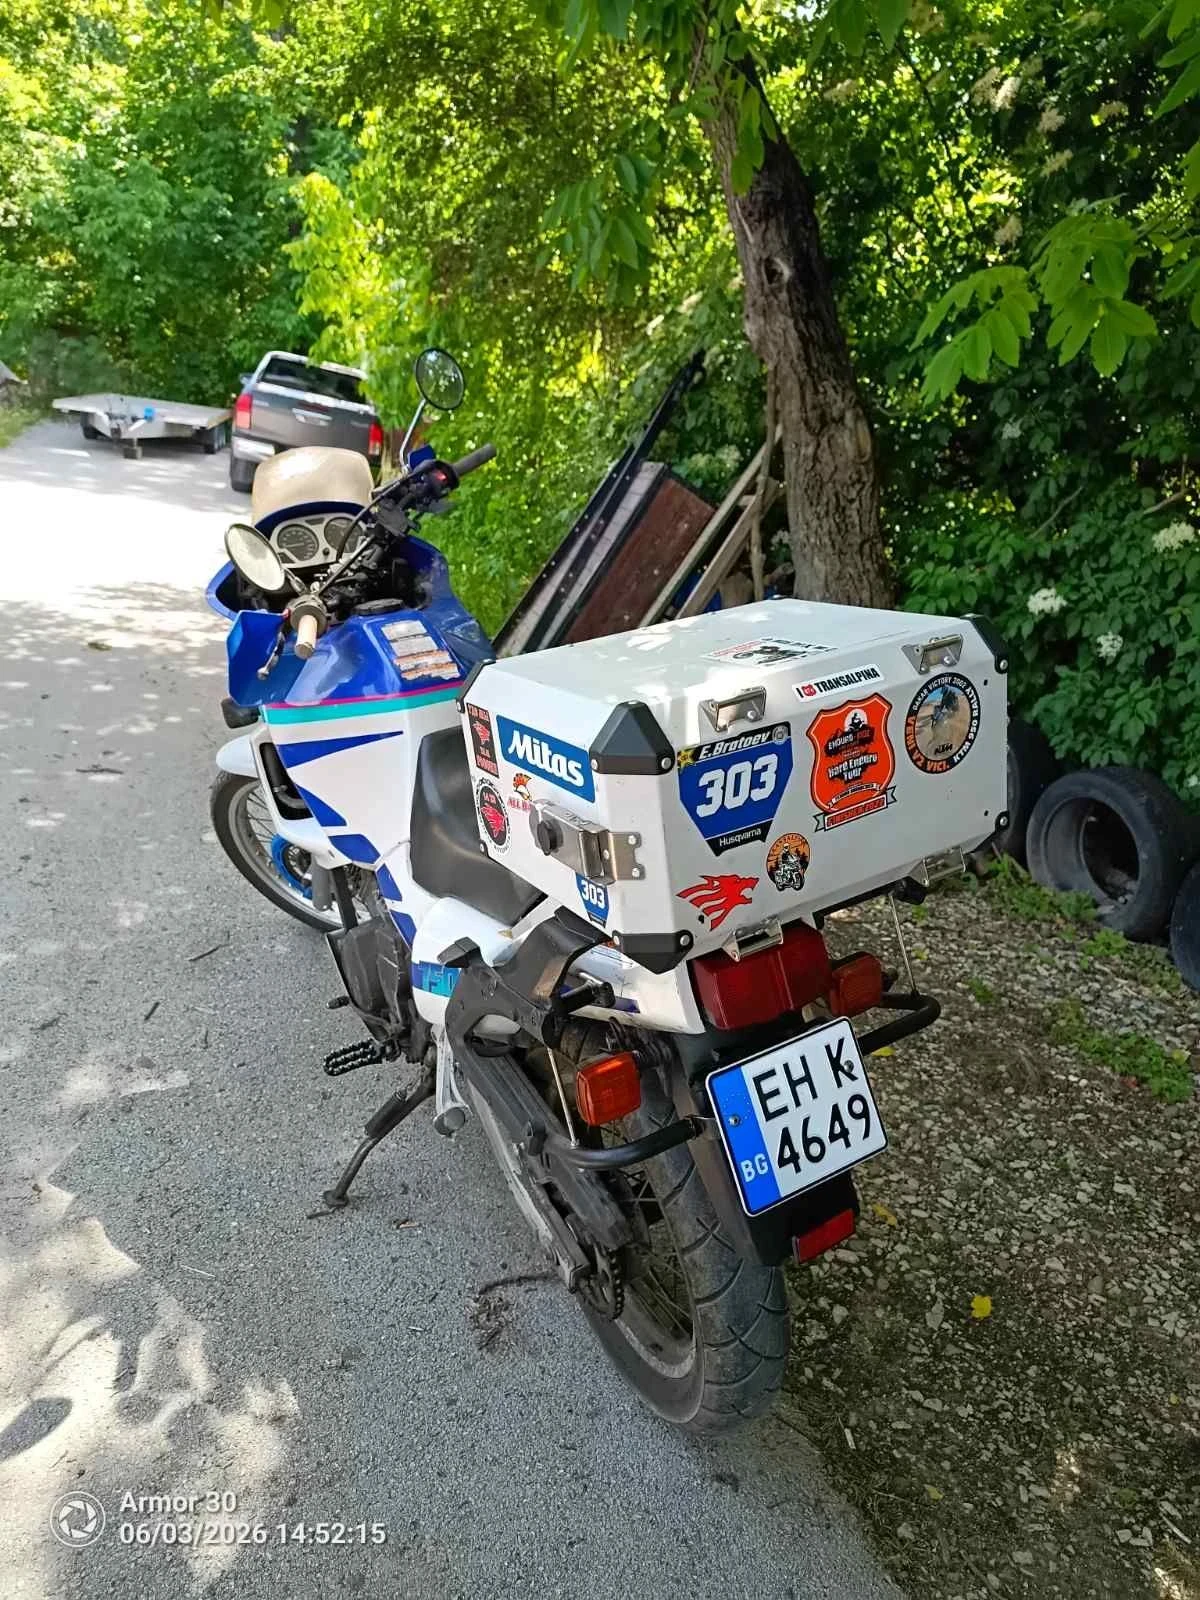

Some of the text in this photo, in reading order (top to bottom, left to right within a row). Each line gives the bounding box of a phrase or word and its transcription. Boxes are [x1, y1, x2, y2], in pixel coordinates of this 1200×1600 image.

[796, 687, 804, 698] I
[814, 667, 881, 693] TRANSALPINA
[912, 688, 929, 711] DAKAR
[927, 676, 953, 691] VICTORY
[906, 715, 917, 750] VENI
[952, 741, 972, 763] KTM
[964, 685, 980, 717] RALLY
[507, 730, 585, 787] Mitas
[698, 730, 771, 760] E.Bratoev
[695, 753, 778, 818] 303
[719, 827, 762, 848] Husqvarna
[580, 879, 605, 909] 303
[752, 1037, 858, 1122] EH K
[776, 1093, 871, 1174] 4649
[740, 1152, 769, 1182] BG
